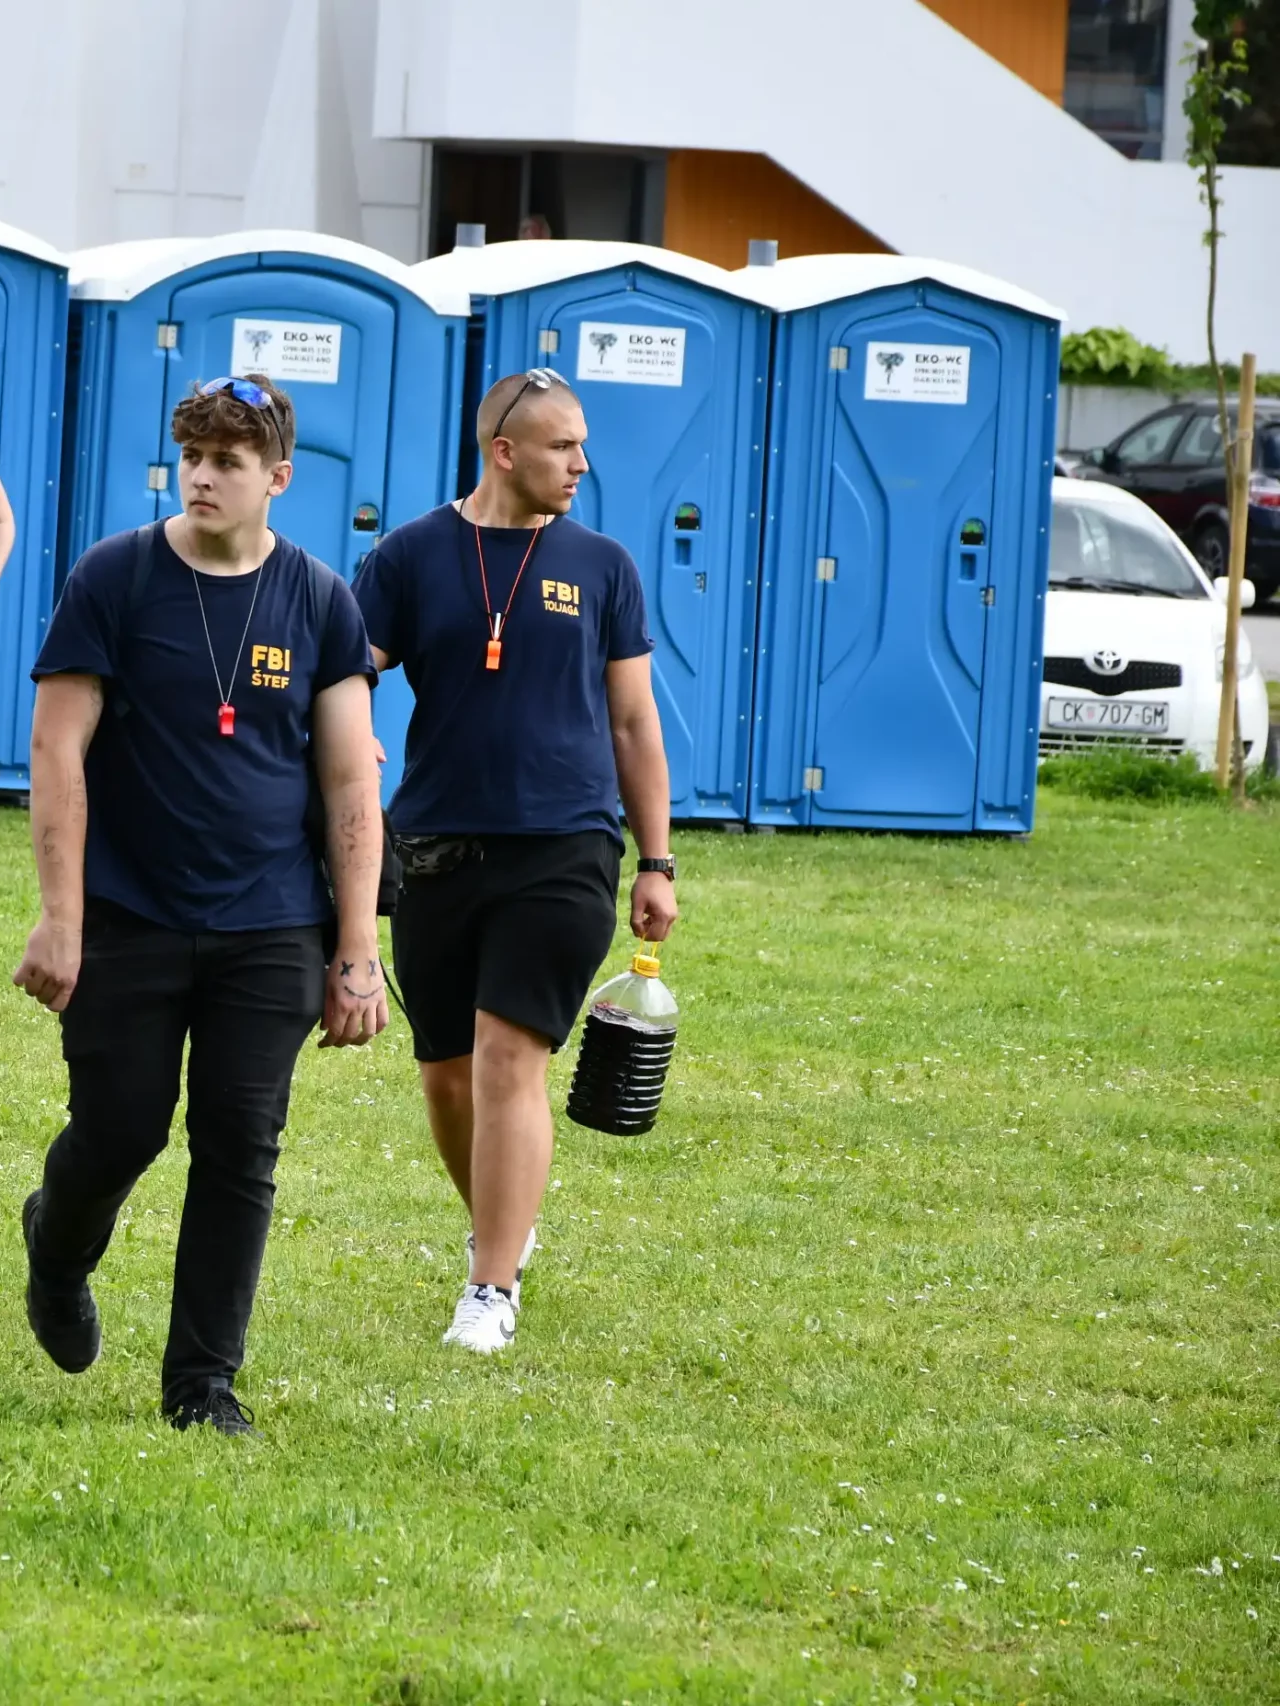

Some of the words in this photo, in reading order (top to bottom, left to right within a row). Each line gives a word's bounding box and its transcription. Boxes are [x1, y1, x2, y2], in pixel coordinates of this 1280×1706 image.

[542, 580, 579, 604] FBI
[251, 645, 290, 671] FBI
[251, 669, 290, 688] ŠTEF
[1062, 702, 1083, 722] CK
